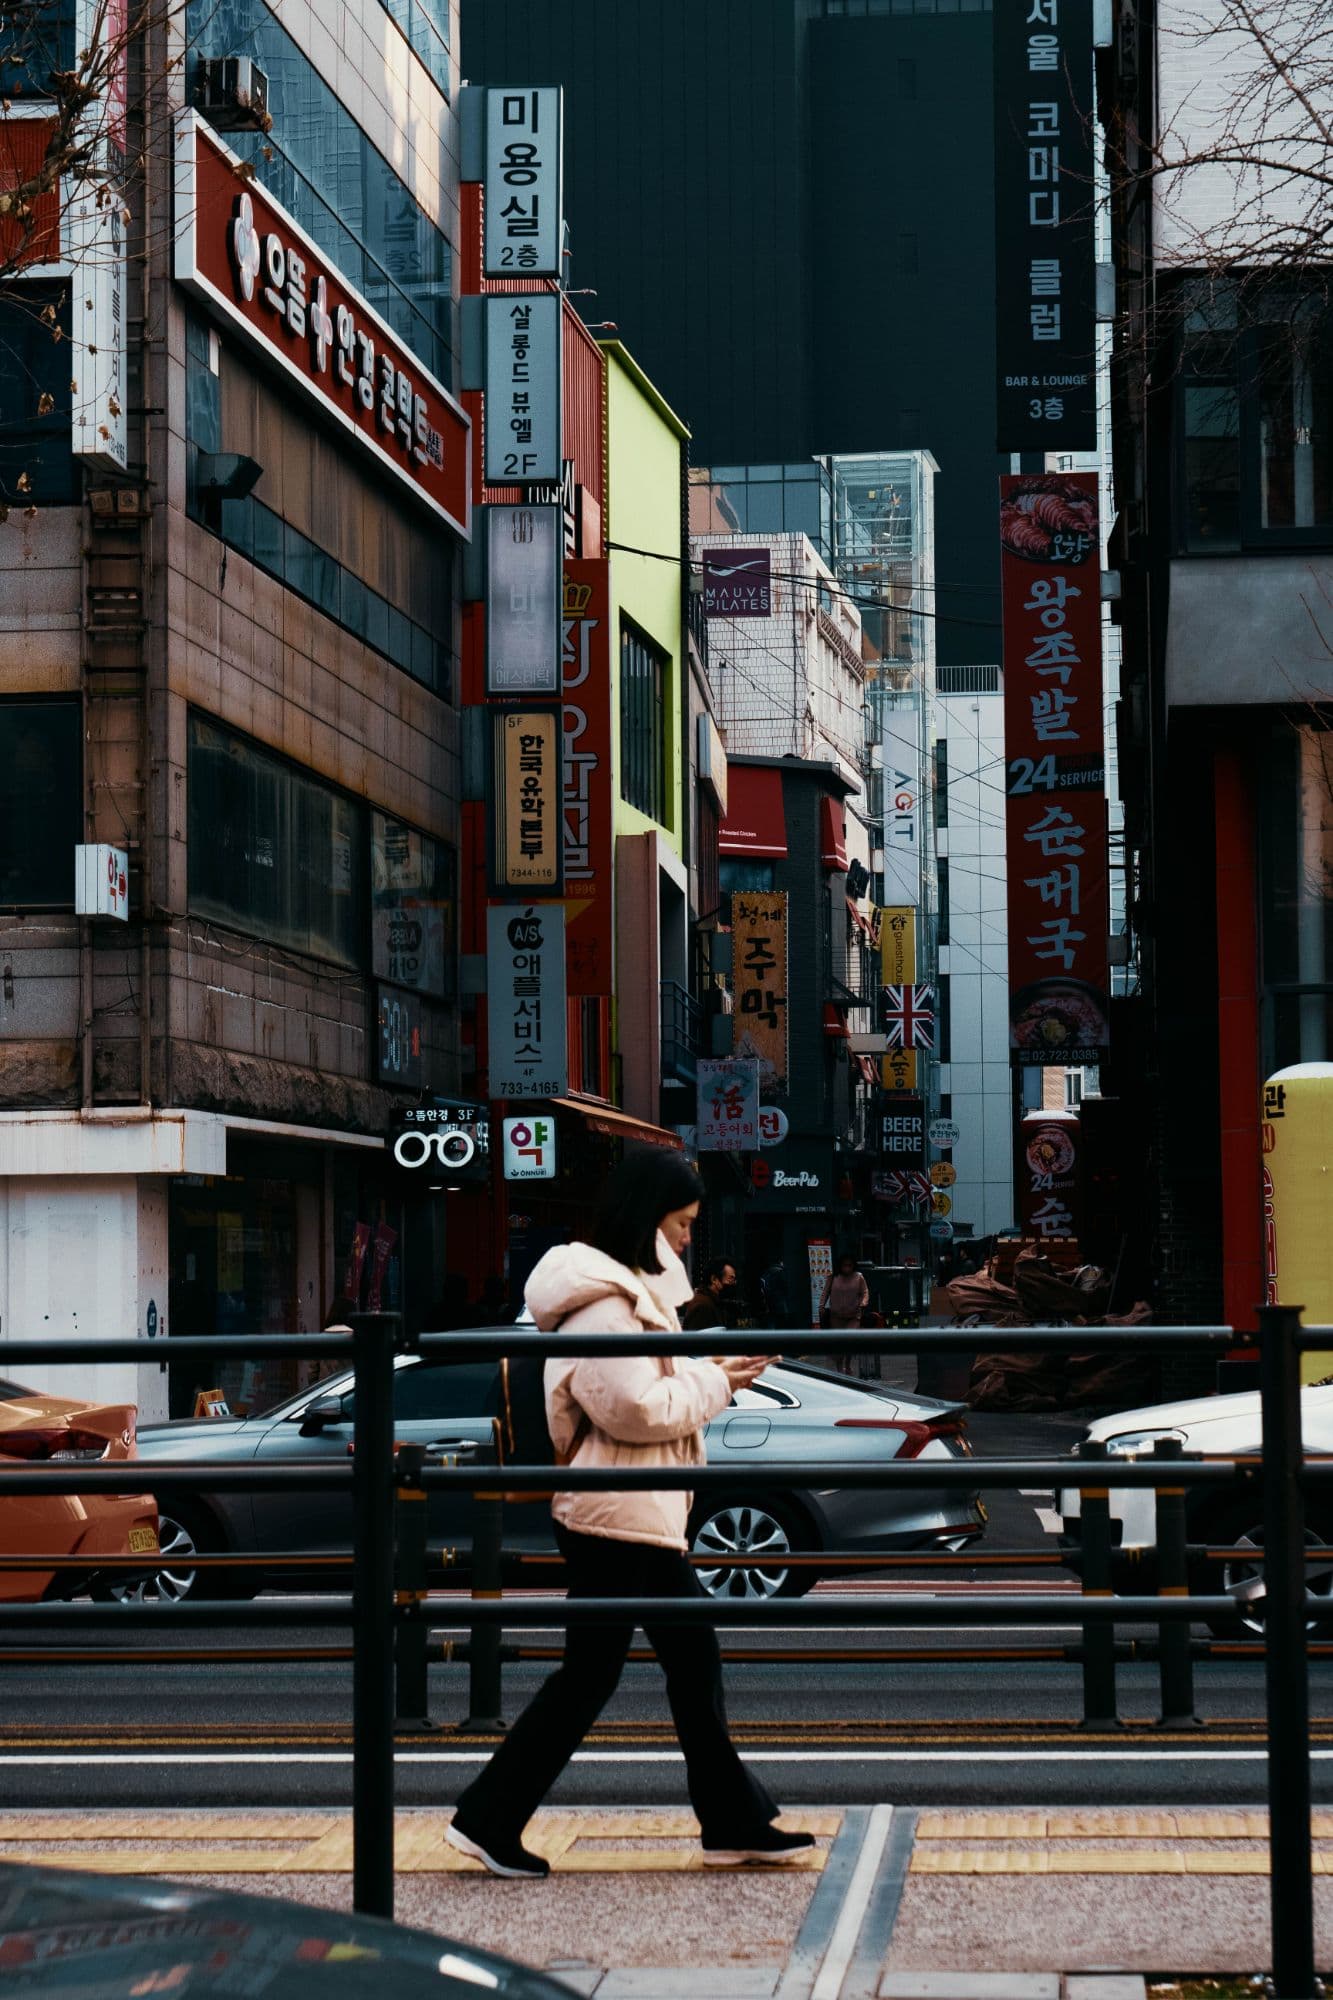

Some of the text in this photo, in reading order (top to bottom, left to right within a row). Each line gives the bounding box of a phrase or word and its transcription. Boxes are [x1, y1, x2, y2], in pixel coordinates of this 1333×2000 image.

[499, 91, 542, 237] 미용실
[1026, 0, 1062, 341] 서울 코미디 클럽
[500, 244, 539, 268] 2층
[264, 233, 306, 338] 으뜸
[337, 303, 375, 410] 안경
[510, 305, 532, 444] 살롱드 뷰엘
[1005, 374, 1088, 387] BAR & LOUNGE
[1029, 397, 1064, 420] 3층
[503, 453, 538, 475] 2F
[705, 587, 769, 598] MAUVE
[705, 599, 769, 611] PILATES
[1023, 576, 1082, 742] 왕족발
[508, 717, 523, 728] 5F
[1006, 754, 1057, 795] 24
[1059, 768, 1104, 787] SERVICE
[519, 734, 544, 860] 한국유학본부
[511, 869, 552, 877] 7344-116
[1023, 806, 1087, 970] 순대국
[514, 924, 538, 942] A/S
[740, 937, 787, 1030] 주막
[512, 954, 542, 1063] 애플서비스
[522, 1068, 535, 1077] 4F
[500, 1081, 559, 1095] 733-4165
[404, 1109, 474, 1121] 으뜸안경 3F
[883, 1117, 922, 1132] BEER
[510, 1121, 548, 1166] 약
[883, 1136, 922, 1152] HERE
[1030, 1173, 1054, 1193] 24
